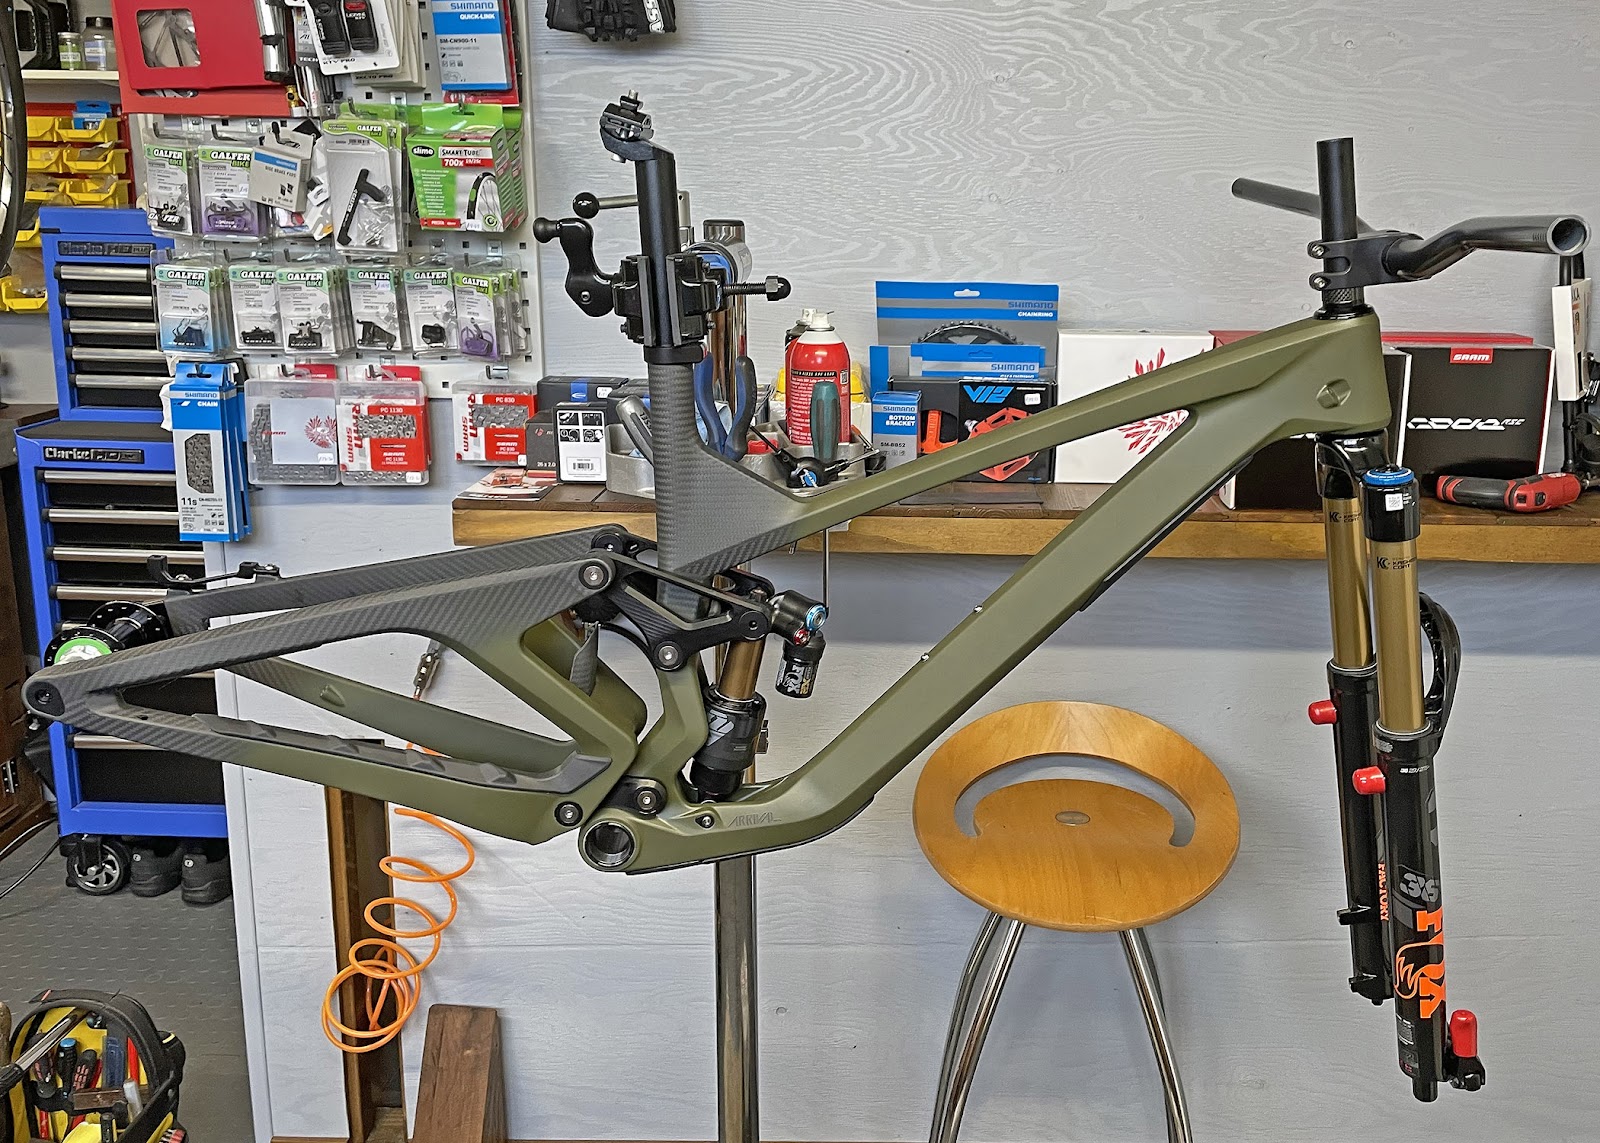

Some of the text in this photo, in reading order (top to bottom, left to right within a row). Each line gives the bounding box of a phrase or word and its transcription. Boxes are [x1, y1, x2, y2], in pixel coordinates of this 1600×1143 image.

[451, 2, 494, 10] SHIMANO
[153, 149, 182, 159] GALFER
[413, 147, 433, 155] slime
[441, 149, 462, 157] SMART
[211, 151, 251, 161] GALFER
[444, 159, 464, 167] 700x
[167, 271, 205, 280] GALFER
[462, 277, 489, 287] GALFER
[1008, 301, 1054, 309] SHIMANO
[991, 363, 1035, 371] SHIMANO
[346, 427, 354, 463] SRAM
[45, 447, 90, 460] Clarke
[181, 497, 198, 506] 11s
[728, 812, 782, 828] ARRIVAL
[1377, 862, 1391, 921] FACTORY
[1400, 872, 1440, 903] 36
